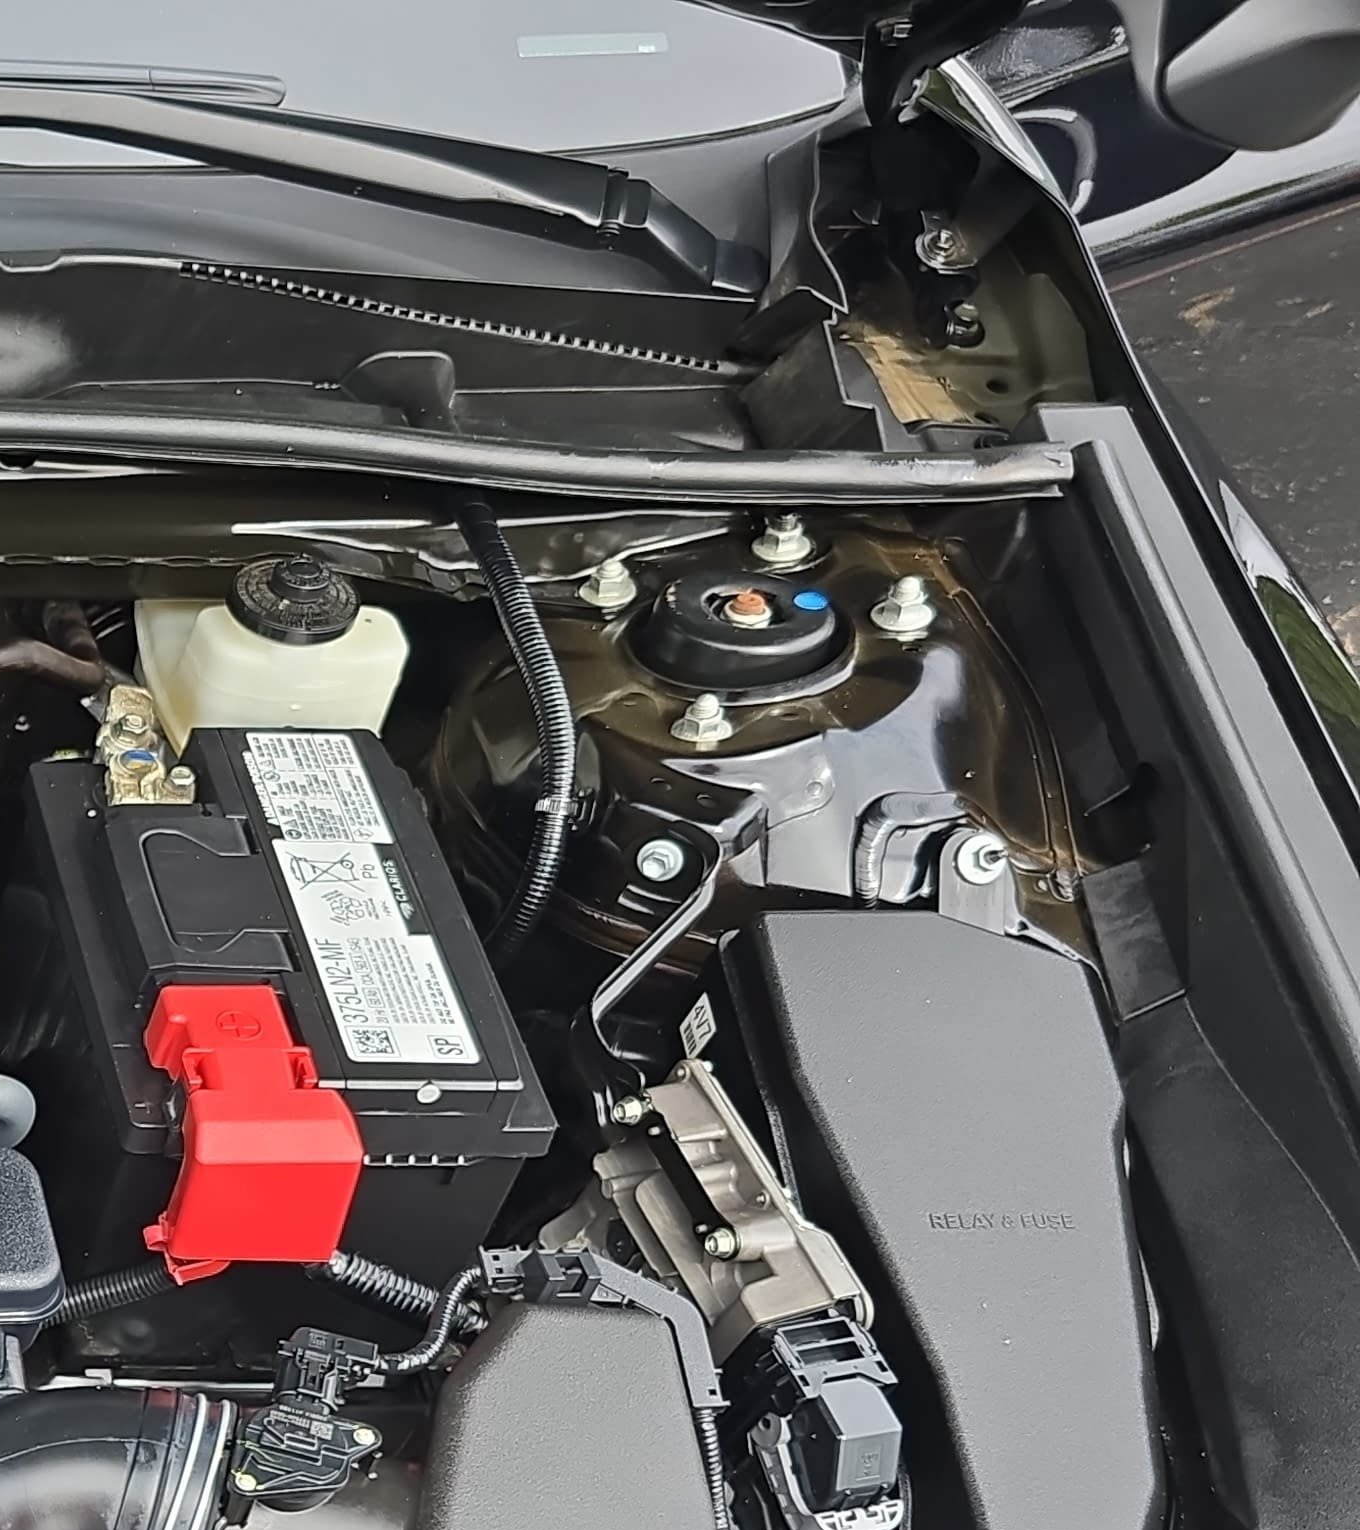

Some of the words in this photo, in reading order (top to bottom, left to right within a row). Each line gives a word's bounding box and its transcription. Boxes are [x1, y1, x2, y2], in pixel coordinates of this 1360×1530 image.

[361, 863, 379, 880] Pb
[383, 858, 407, 904] CLARIOS
[314, 937, 369, 1024] 375LN2-MF
[433, 1037, 464, 1056] SP
[928, 1212, 995, 1231] RELAY
[1001, 1213, 1015, 1230] &
[1021, 1212, 1076, 1230] FUSE
